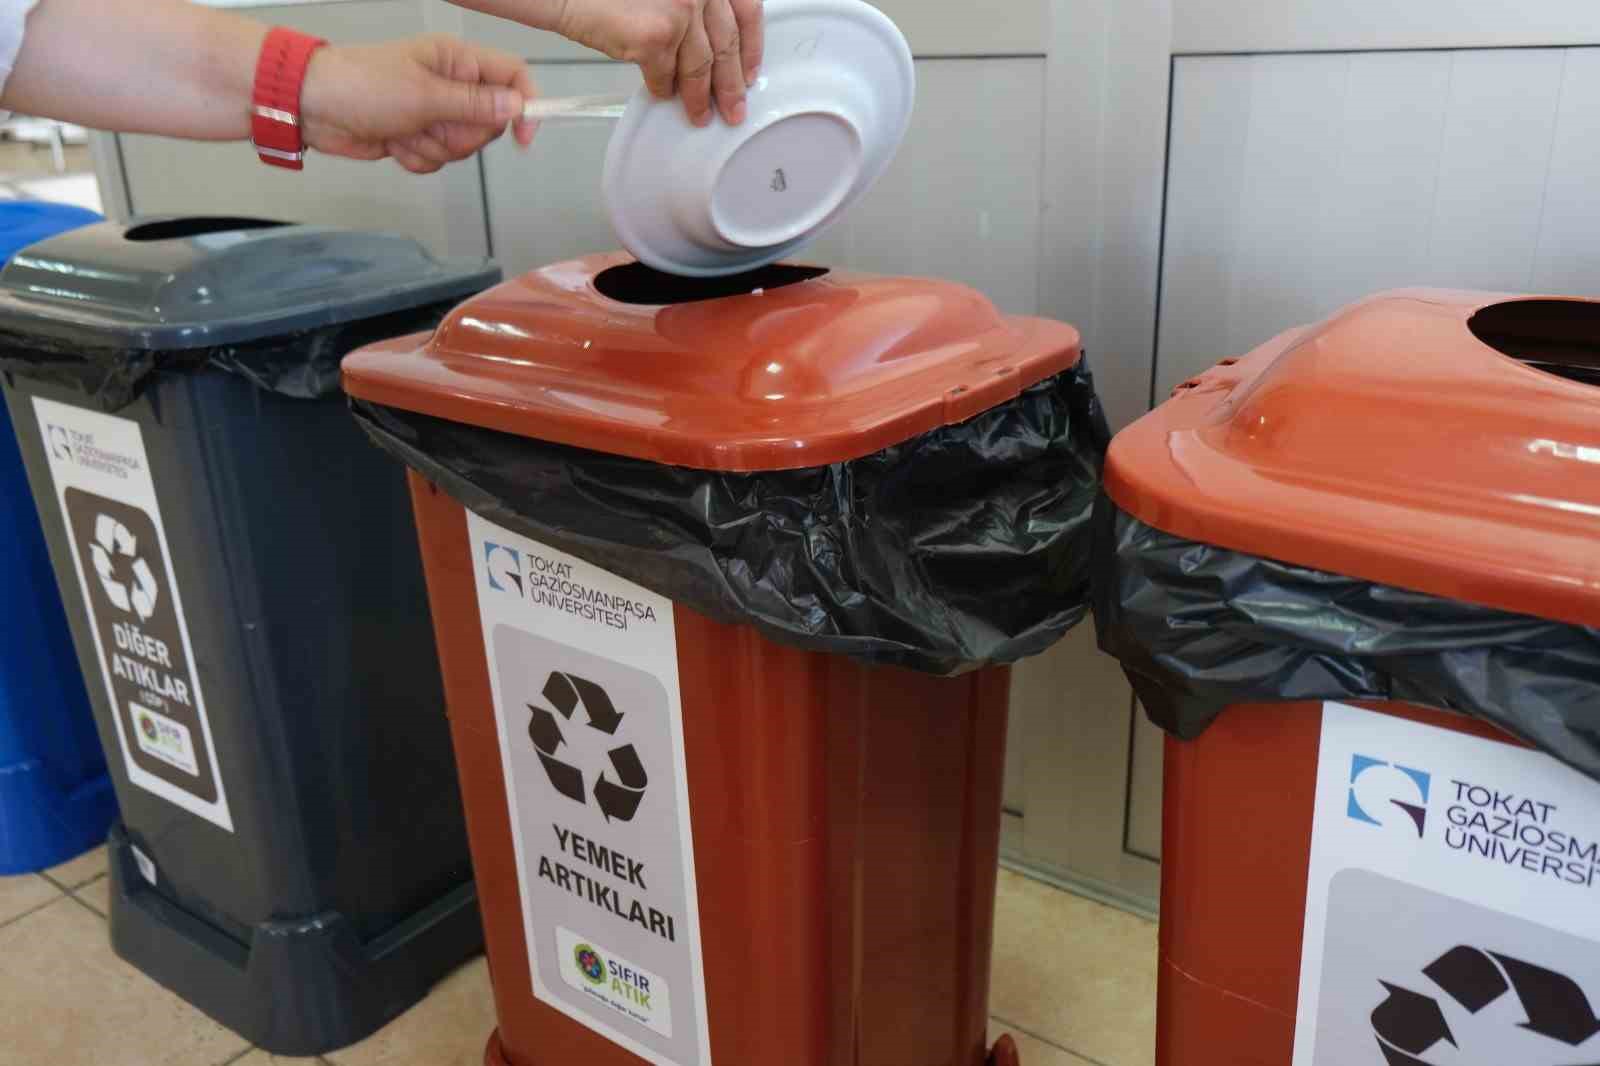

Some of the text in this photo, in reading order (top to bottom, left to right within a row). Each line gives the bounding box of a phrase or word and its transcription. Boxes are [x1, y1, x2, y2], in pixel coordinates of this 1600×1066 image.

[527, 554, 572, 578] TOKAT
[112, 622, 172, 668] DİĞER
[112, 652, 191, 706] ATIKLAR
[1450, 779, 1557, 823] TOKAT
[553, 823, 647, 890] YEMEK
[1445, 825, 1600, 887] ÜNİVERSİ
[1447, 806, 1600, 863] GAZİOSM
[538, 855, 675, 942] ARTIKLARI
[608, 960, 650, 992] SIFIR
[611, 977, 651, 1011] ATIK
